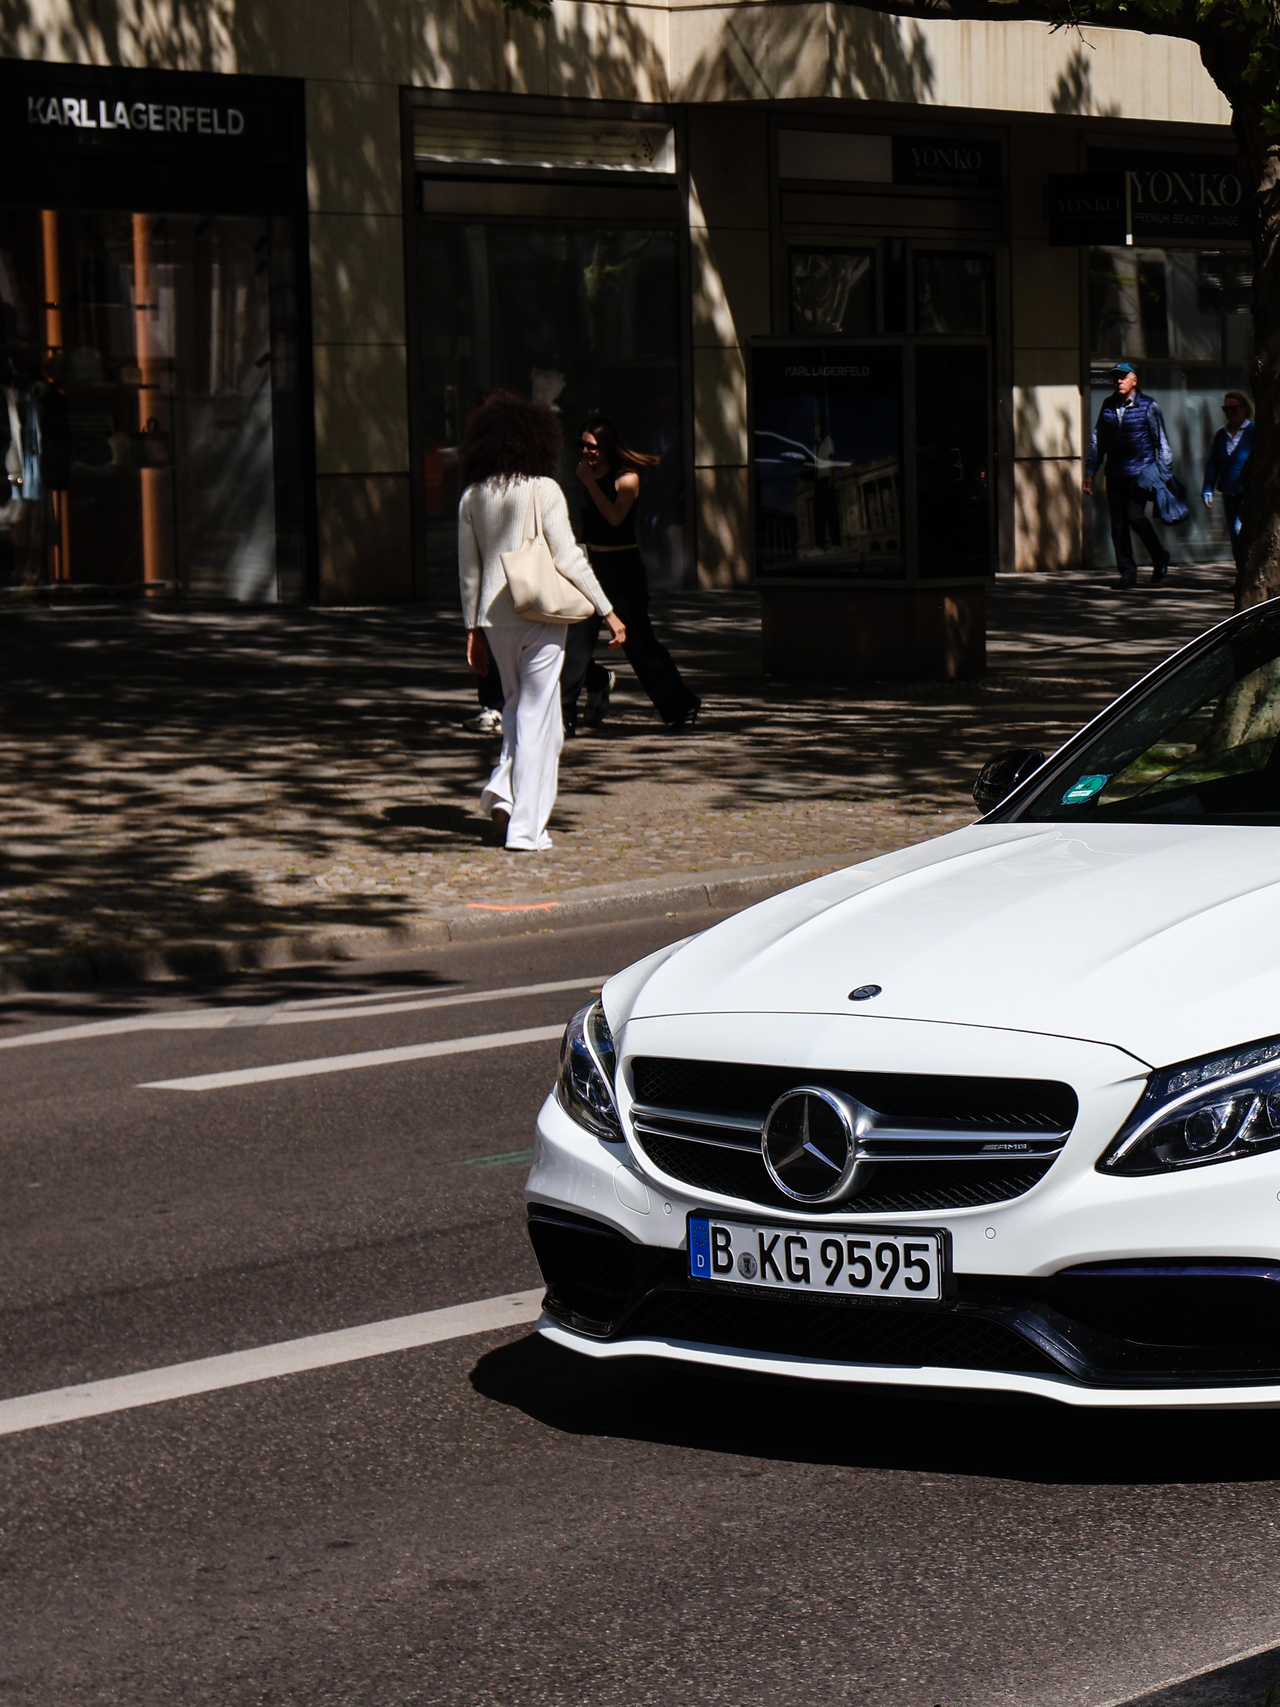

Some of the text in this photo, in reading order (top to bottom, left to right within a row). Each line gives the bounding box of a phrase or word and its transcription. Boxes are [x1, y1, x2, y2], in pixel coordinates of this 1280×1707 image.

[27, 96, 244, 136] KARL LAGERFELD
[910, 147, 982, 170] YONKO
[1129, 170, 1242, 207] YONKO
[1056, 197, 1120, 213] YONKO
[1134, 212, 1238, 226] PREMIUM BEAUTY LOUNGE
[784, 366, 870, 377] KARL LAGERFELD
[697, 1254, 705, 1268] D
[711, 1226, 931, 1291] B KG 9595
